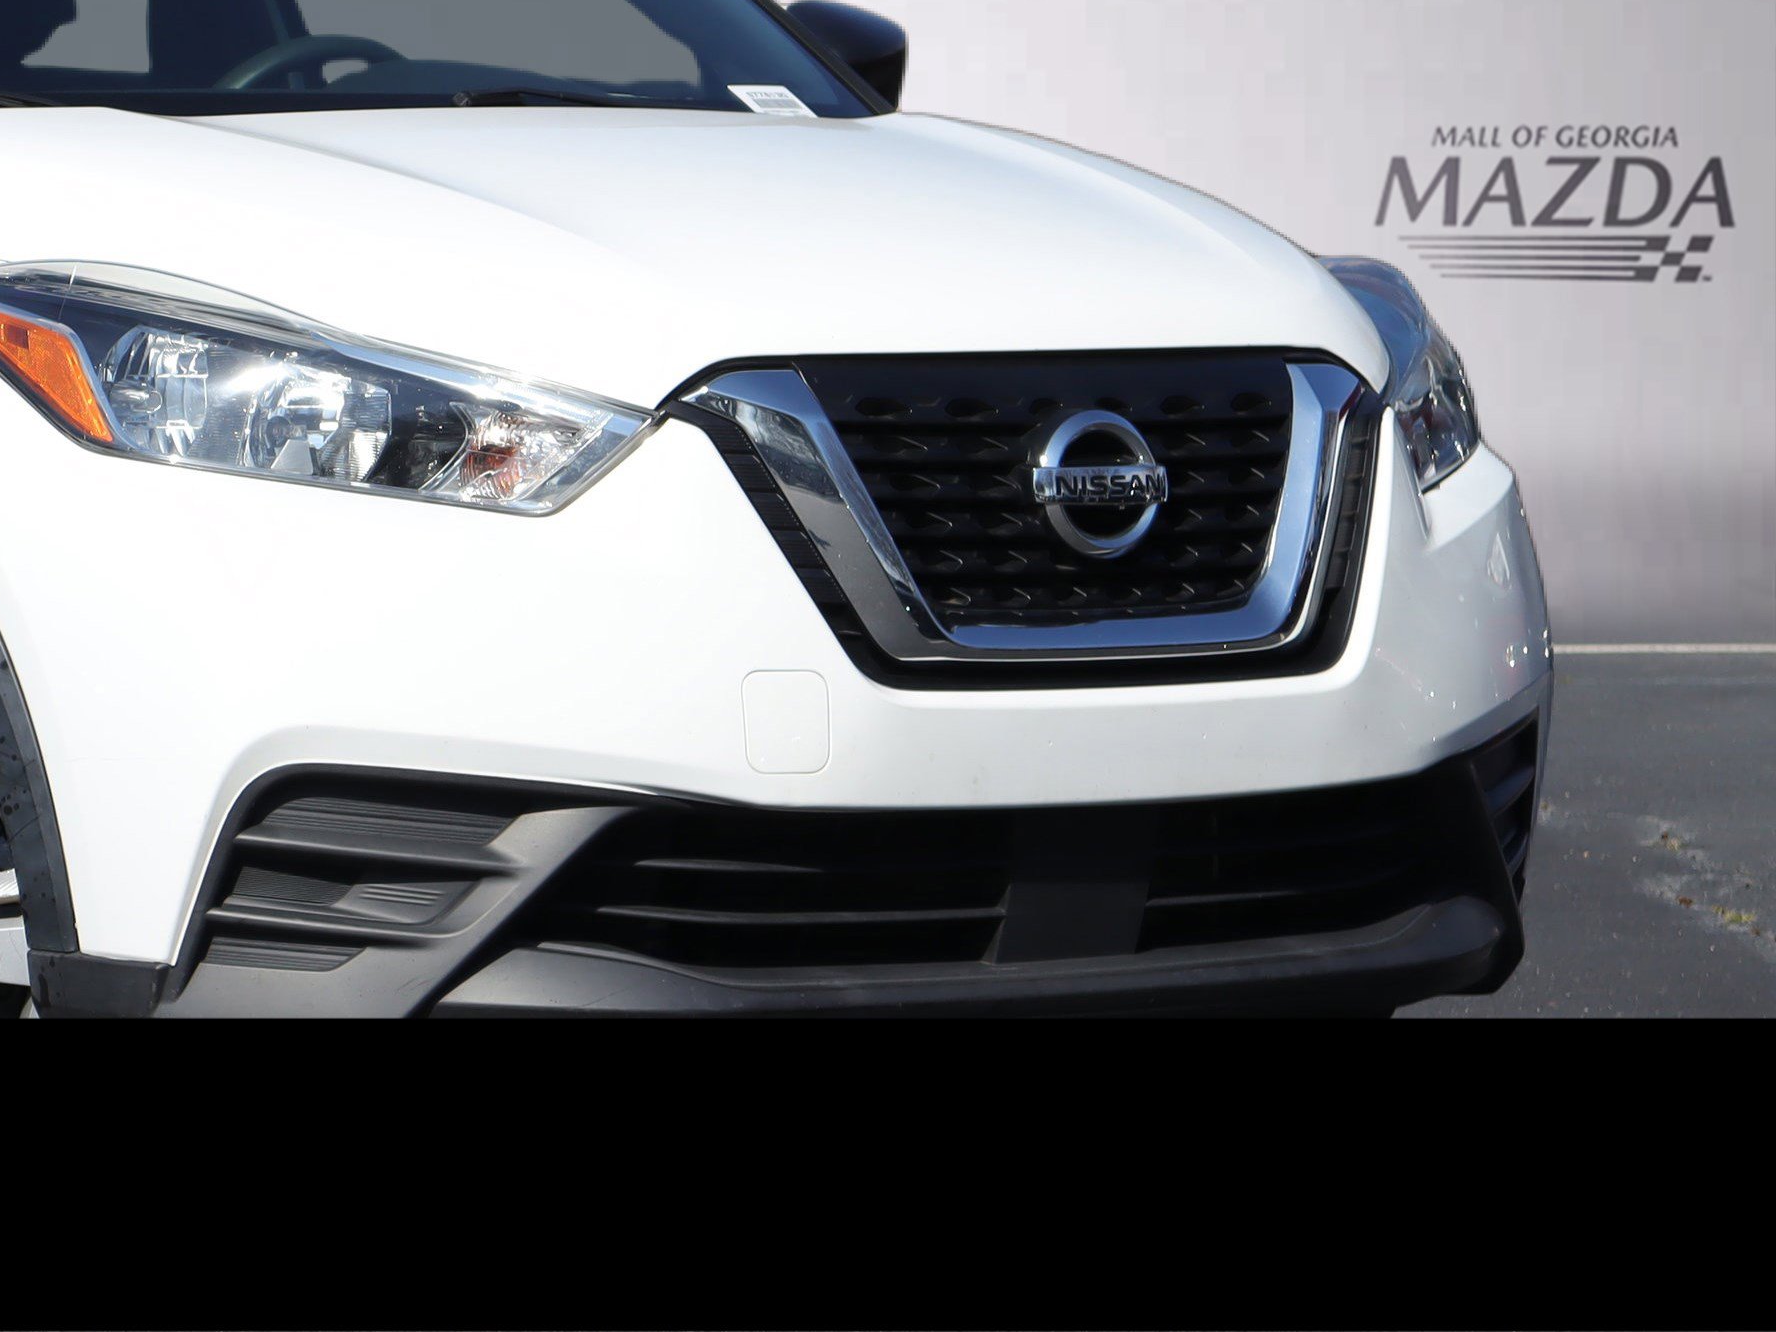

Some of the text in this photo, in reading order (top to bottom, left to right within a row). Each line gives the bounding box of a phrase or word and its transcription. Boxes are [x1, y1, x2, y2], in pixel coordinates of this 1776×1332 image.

[1431, 125, 1679, 149] MALL OF GEORGIA
[1374, 155, 1736, 229] MAZDA
[1055, 473, 1162, 497] NISSAN
